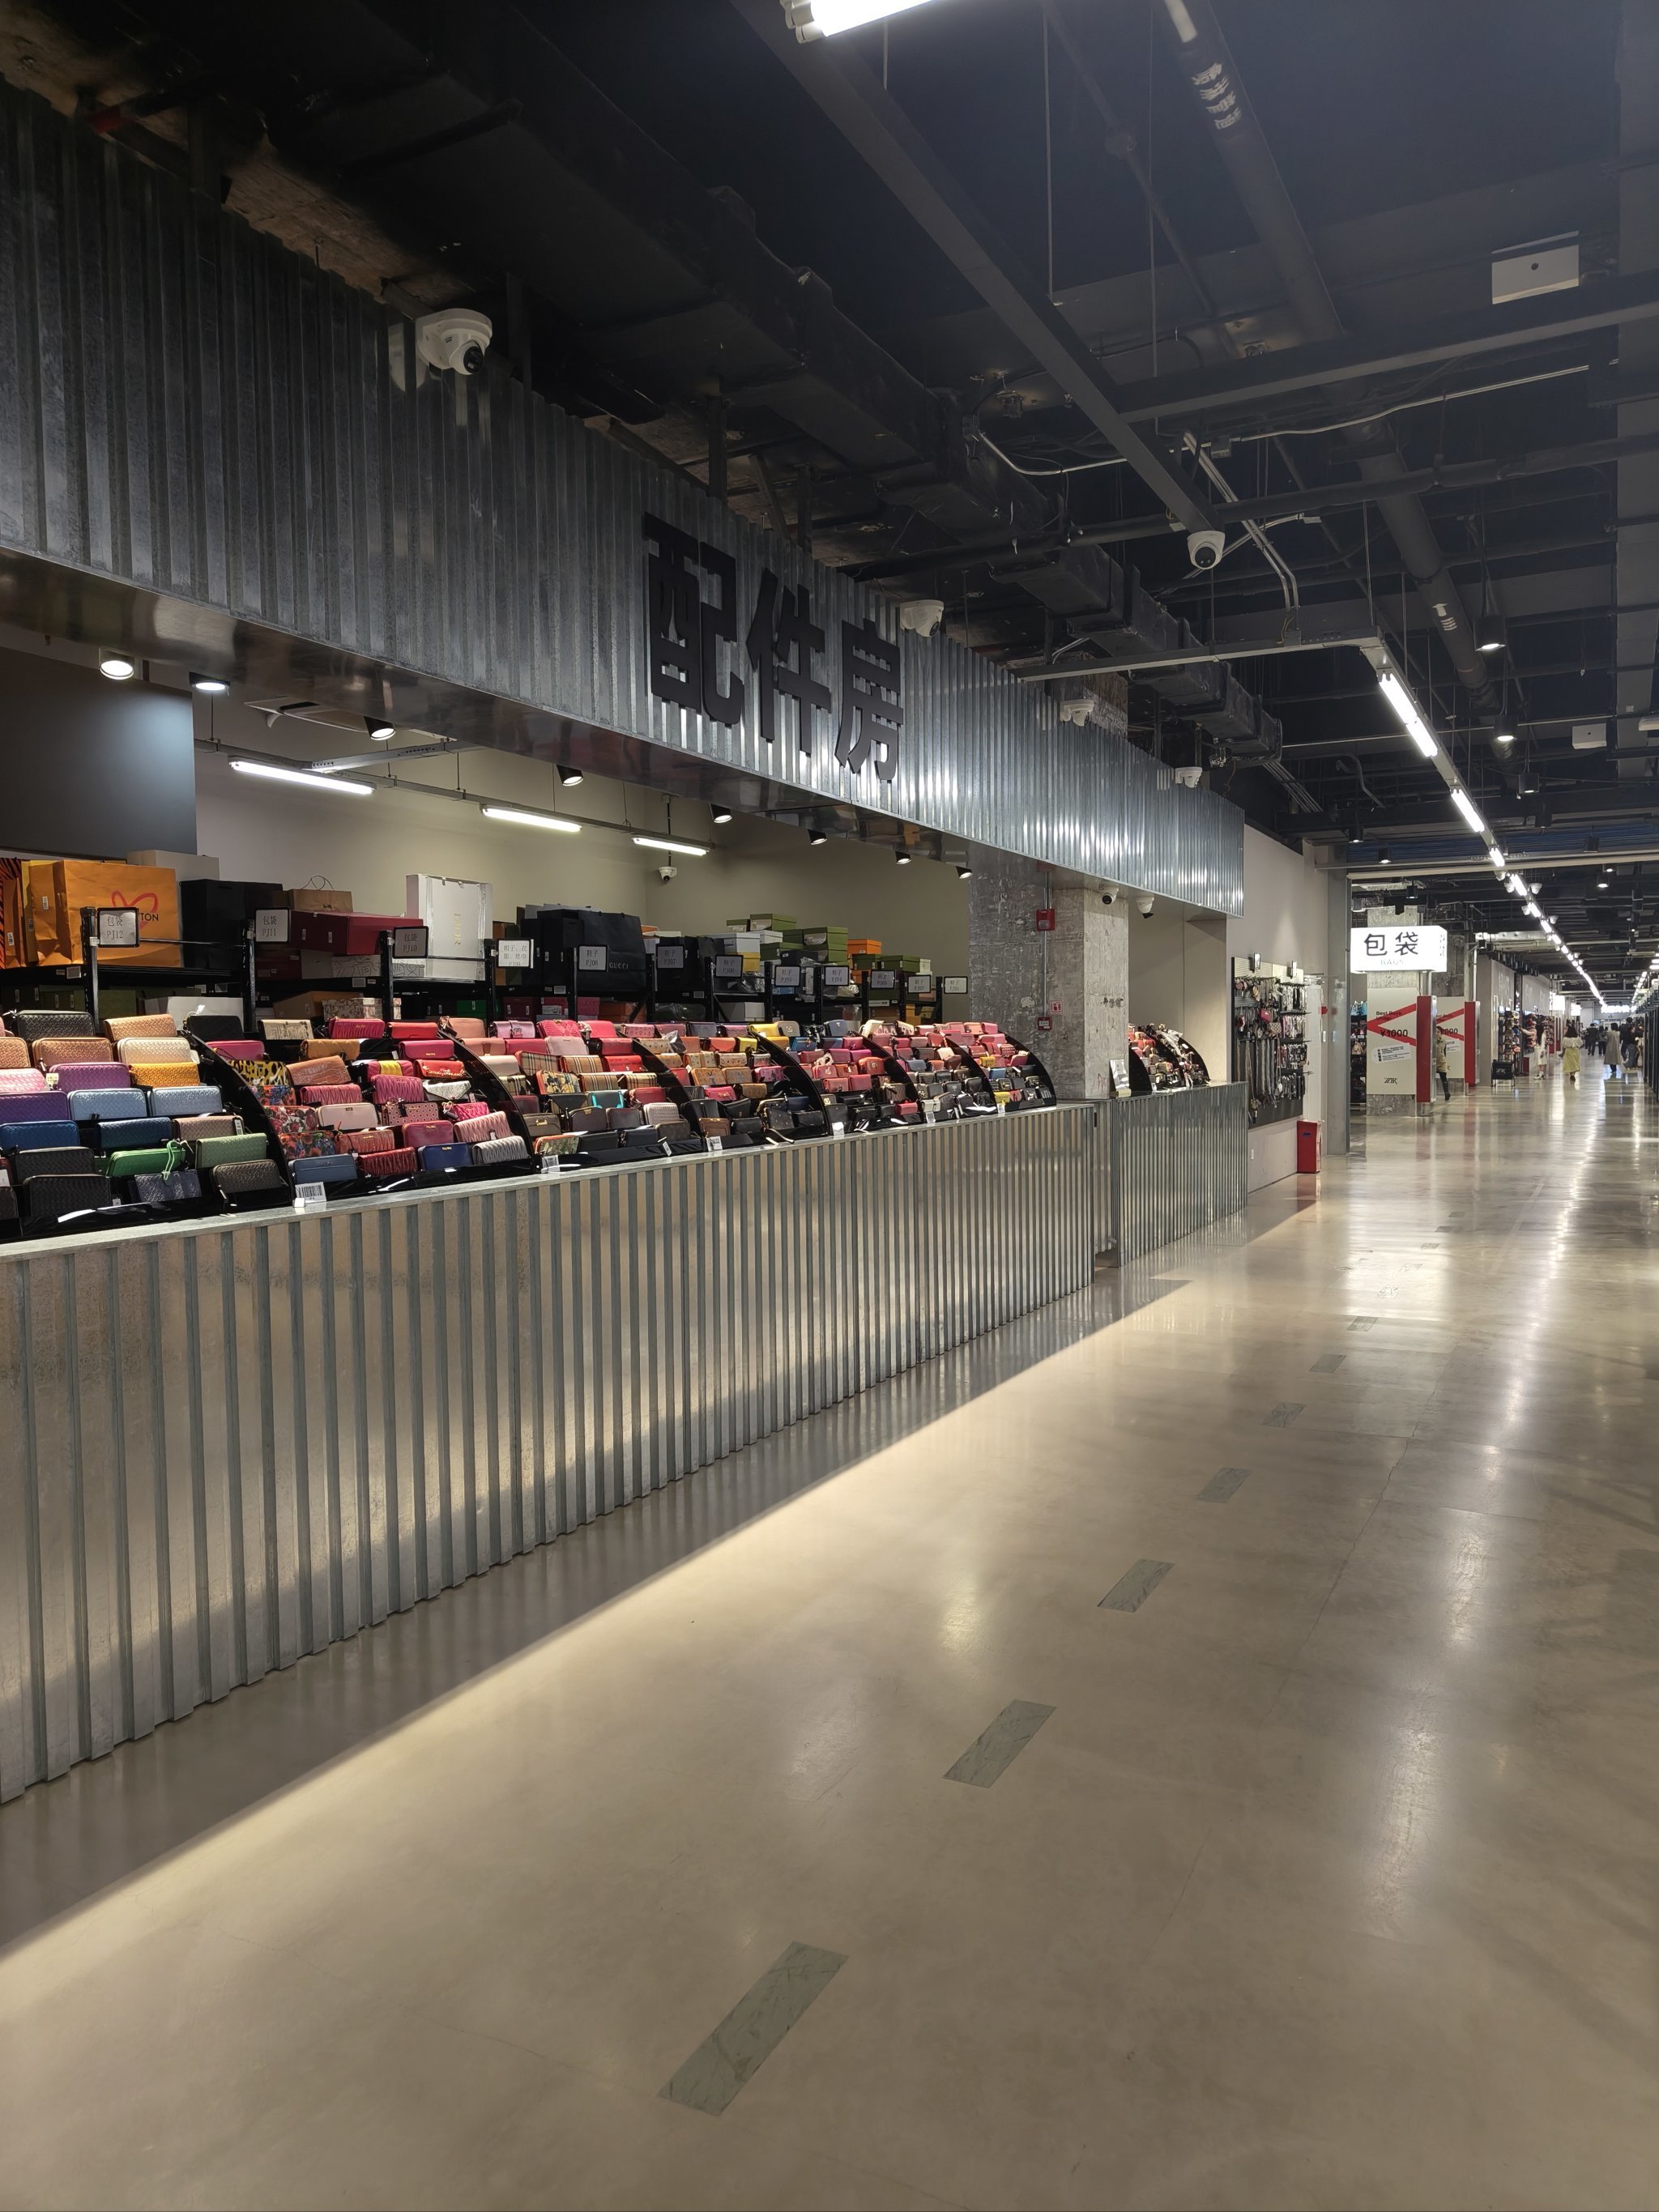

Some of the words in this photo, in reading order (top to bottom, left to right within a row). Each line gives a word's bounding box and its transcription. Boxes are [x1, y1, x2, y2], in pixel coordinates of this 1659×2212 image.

[642, 511, 903, 783] 配件房
[107, 915, 123, 927] 包袋
[139, 913, 159, 921] TON
[262, 915, 277, 925] 包袋
[106, 930, 123, 940] PJ12
[262, 928, 276, 937] PJ11
[403, 944, 417, 953] PJ10
[1363, 931, 1418, 957] 包袋
[609, 961, 629, 970] GUCCI
[1380, 1029, 1409, 1038] ¥1000
